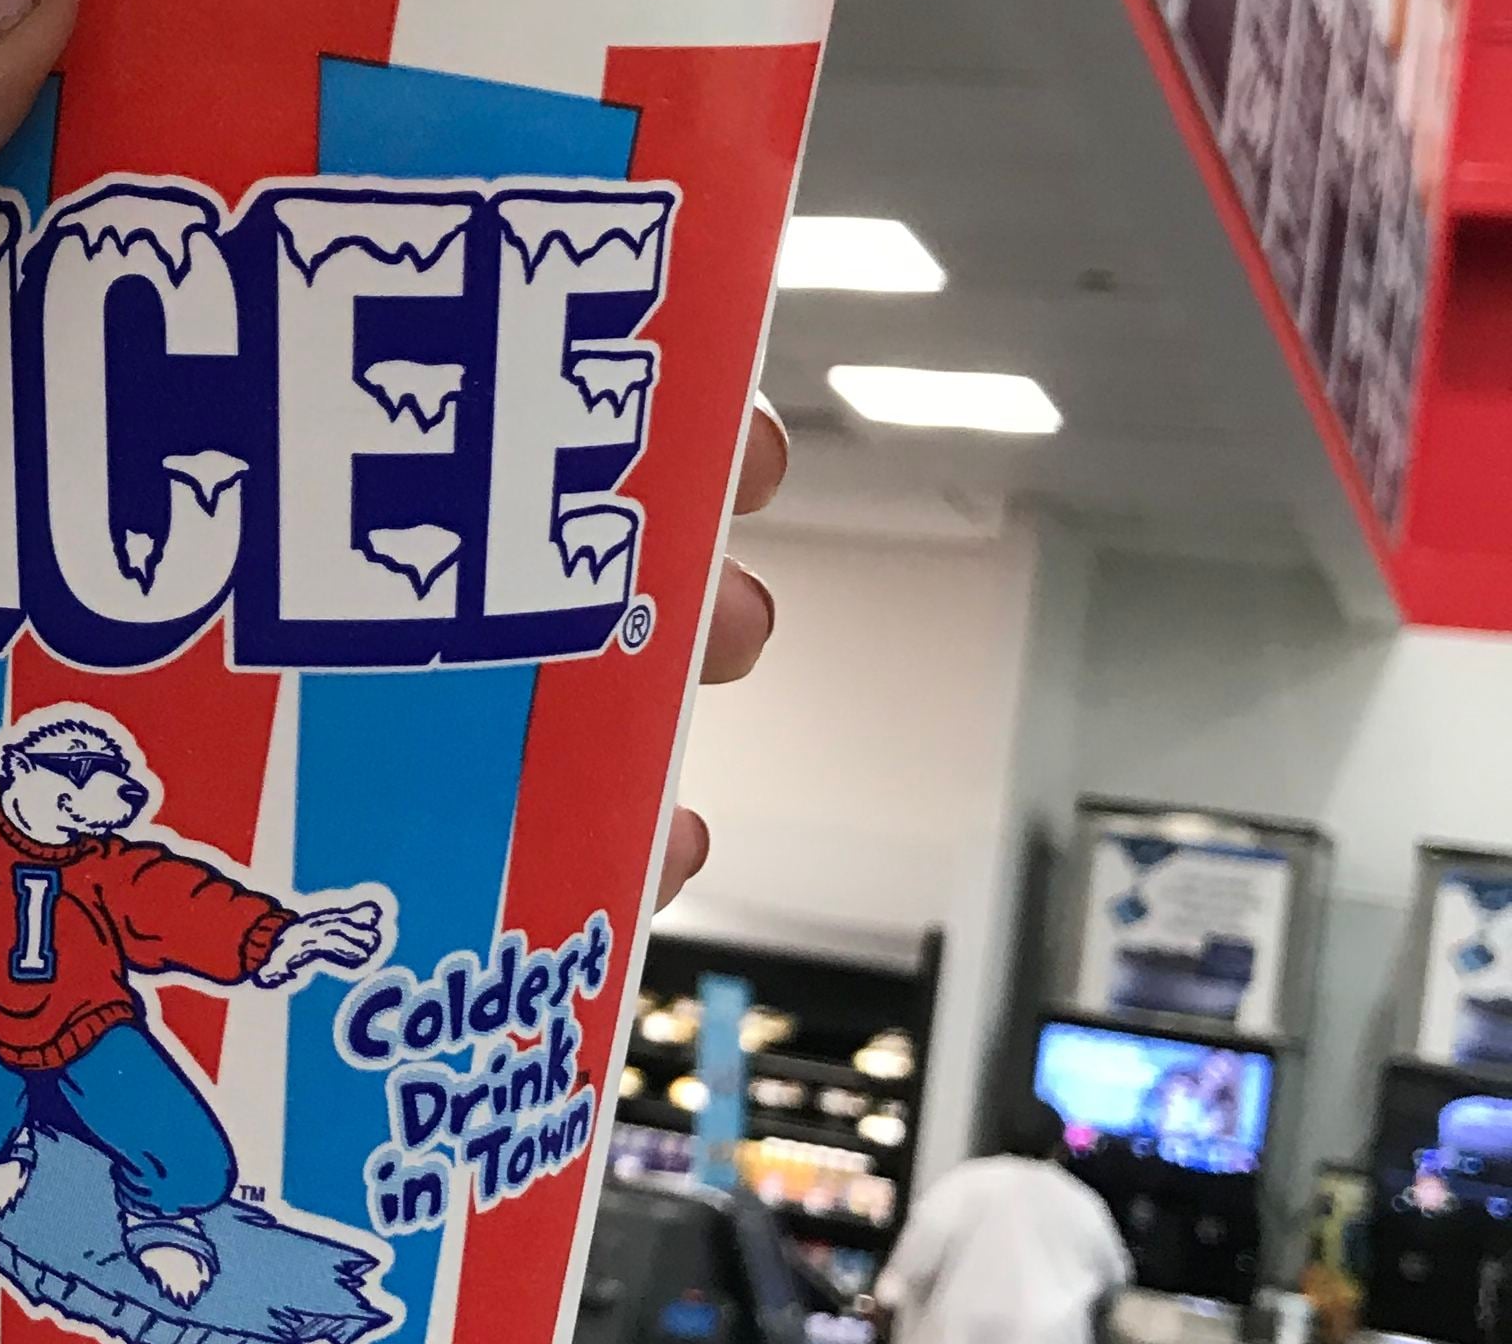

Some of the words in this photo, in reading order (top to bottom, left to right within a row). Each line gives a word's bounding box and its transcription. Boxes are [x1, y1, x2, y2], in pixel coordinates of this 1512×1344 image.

[348, 925, 607, 1058] Coldest
[400, 1016, 574, 1148] Drink
[377, 1160, 443, 1225] in
[466, 1100, 590, 1199] Town
